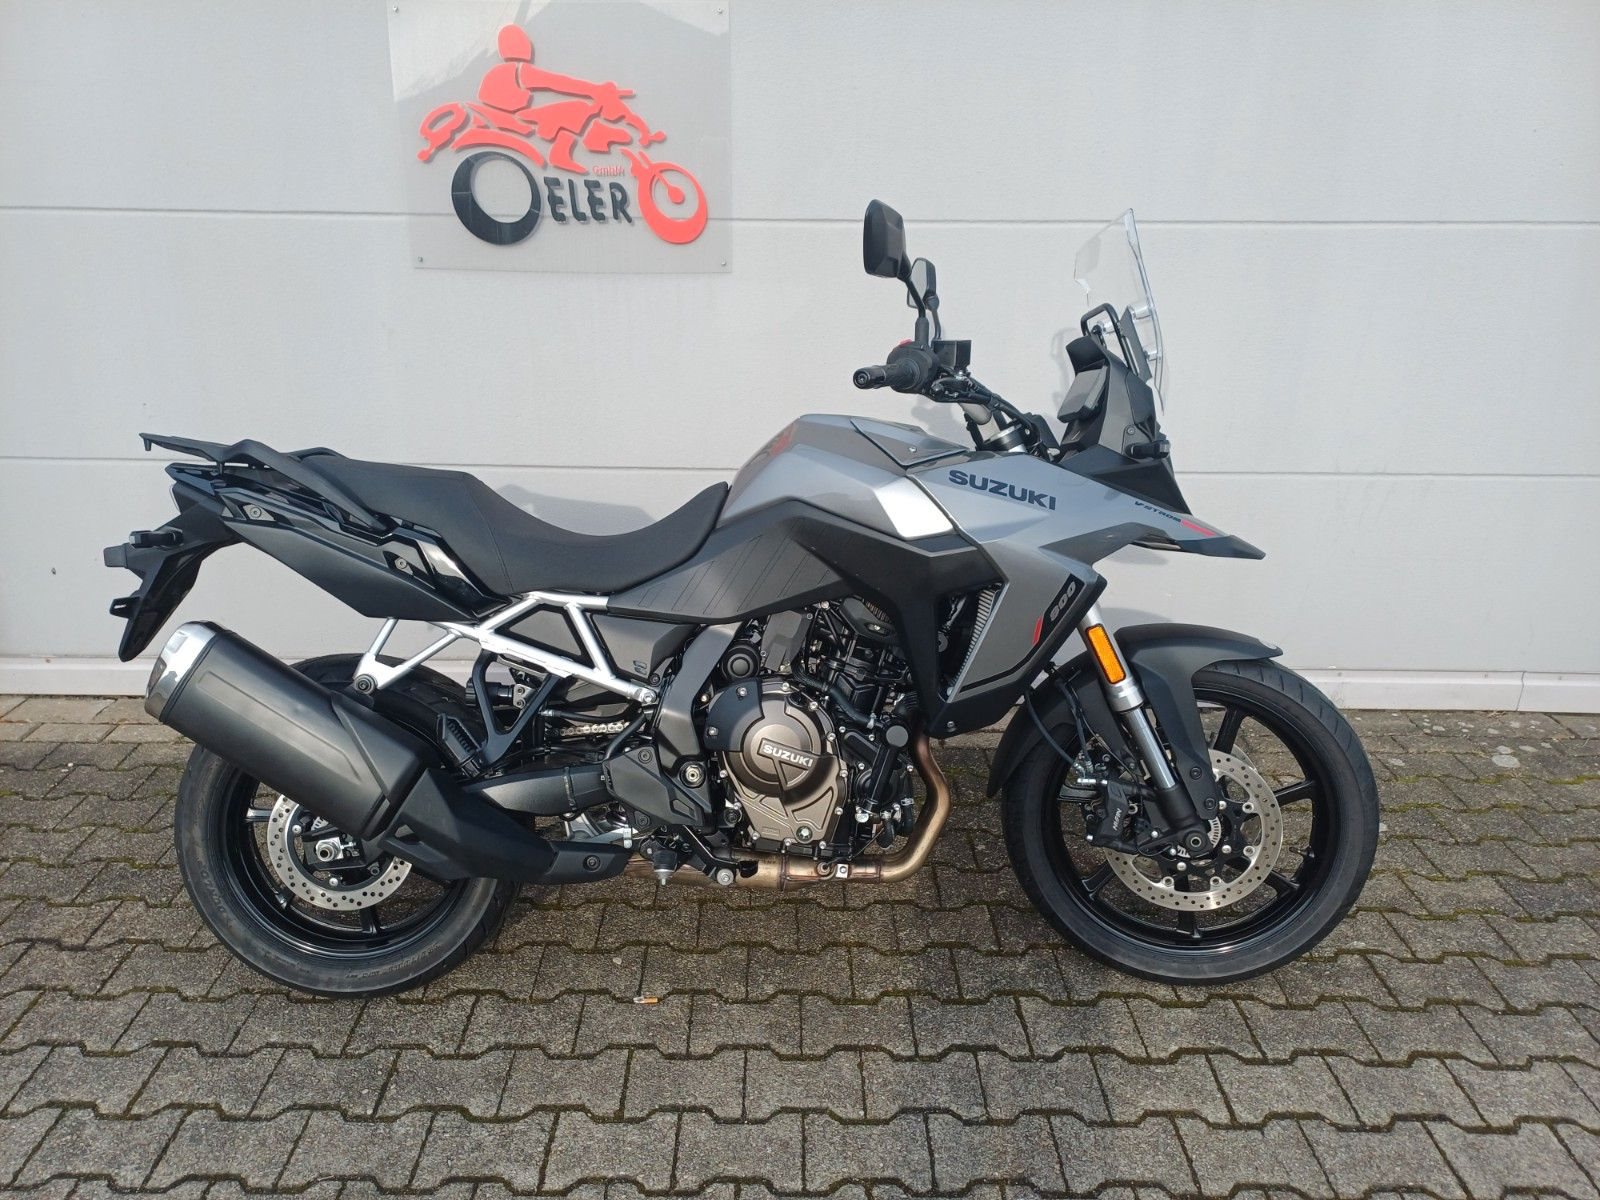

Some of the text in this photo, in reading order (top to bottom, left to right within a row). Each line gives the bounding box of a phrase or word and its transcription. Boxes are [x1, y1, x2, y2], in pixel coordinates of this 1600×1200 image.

[593, 165, 625, 177] GmbH
[948, 469, 1057, 511] SUZUKI
[1049, 581, 1077, 622] 800
[763, 744, 814, 767] SUZUKI
